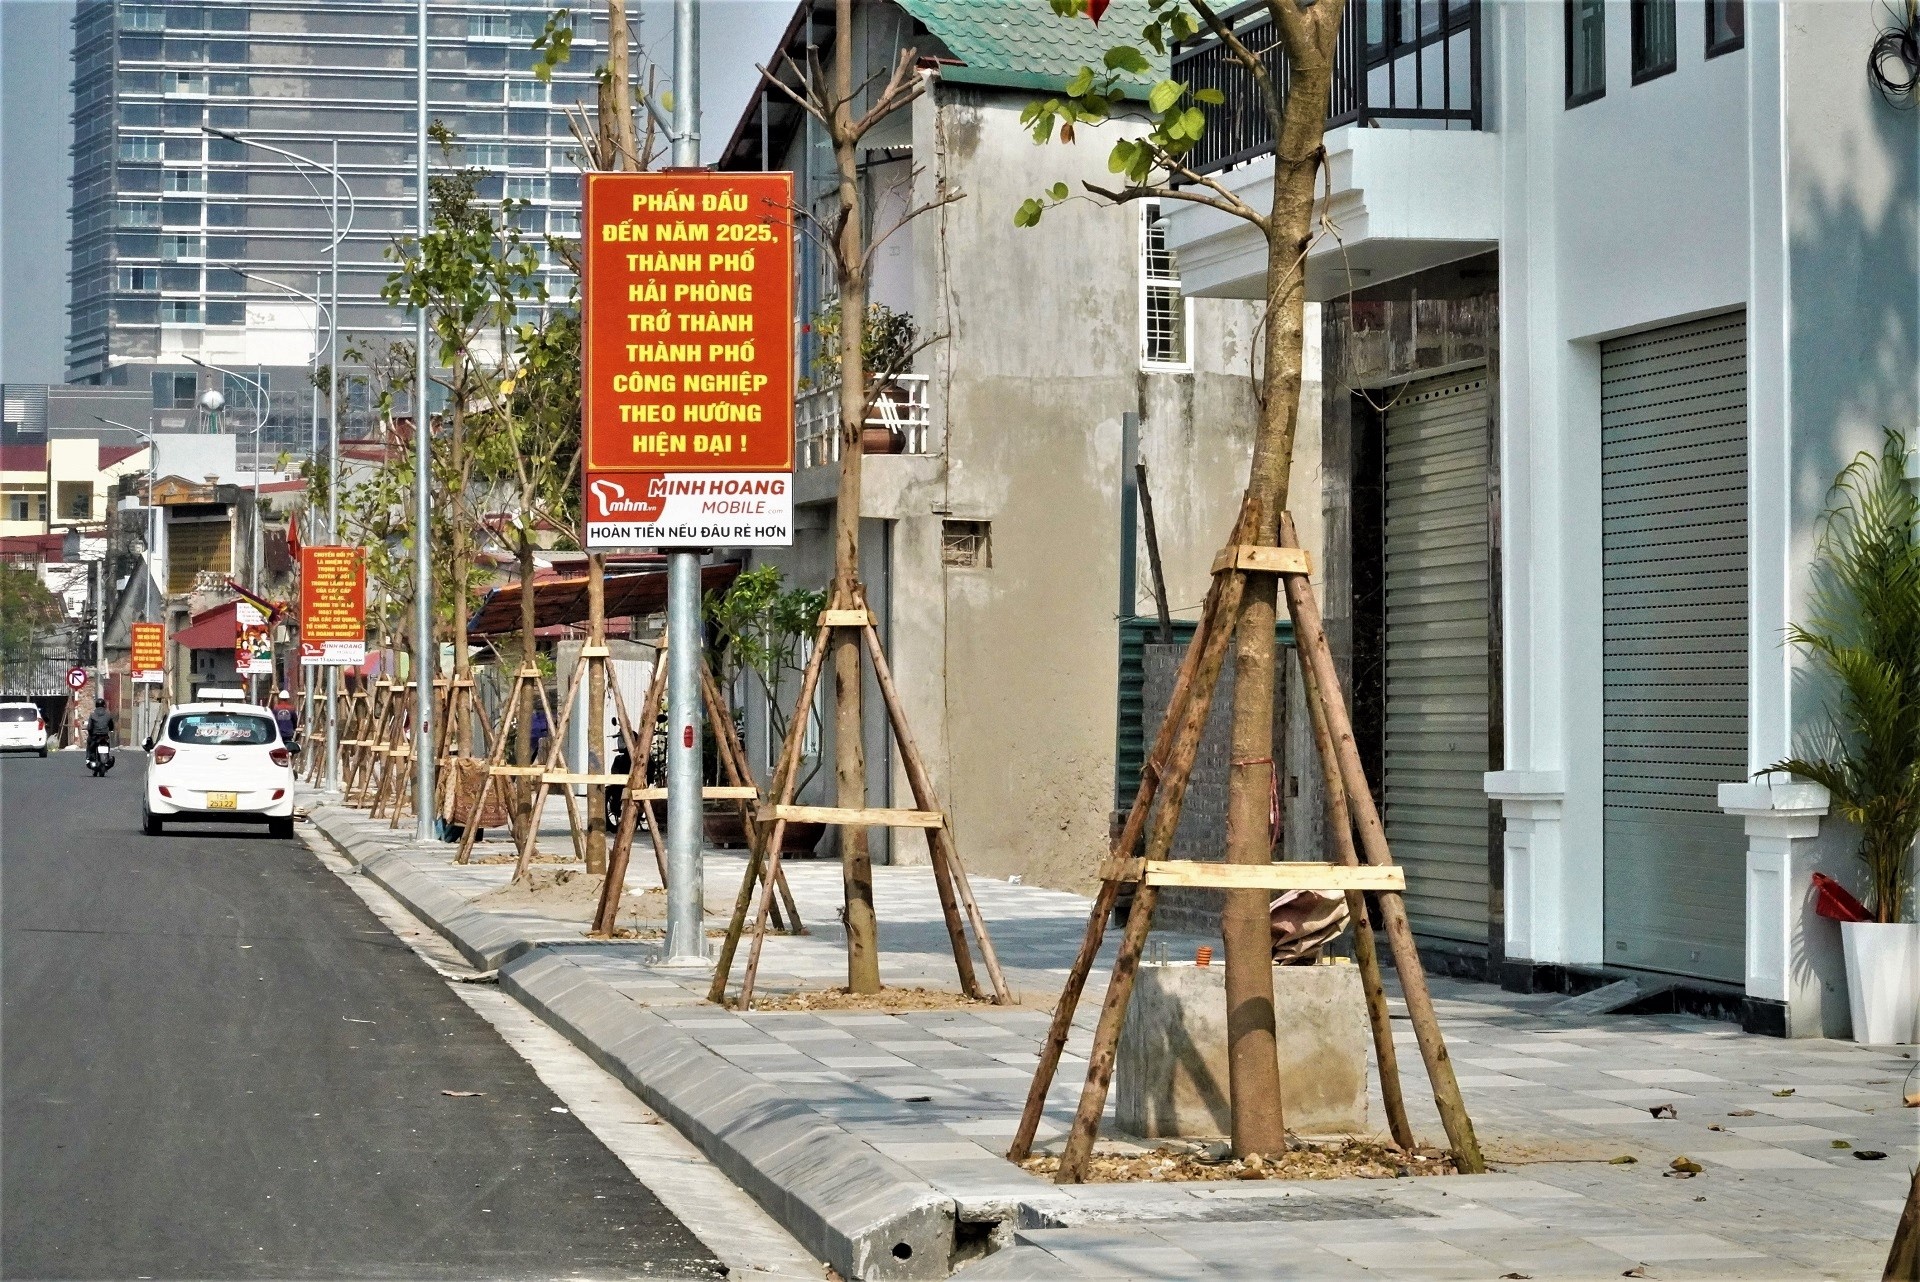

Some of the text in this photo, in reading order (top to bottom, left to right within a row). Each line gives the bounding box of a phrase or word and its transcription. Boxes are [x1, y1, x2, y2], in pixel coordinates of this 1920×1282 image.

[633, 188, 748, 212] PHẤN ĐẤU
[602, 218, 778, 244] ĐẾN NĂM 2025,
[627, 248, 755, 272] THÀNH PHỐ
[629, 278, 753, 302] HẢI PHÒNG
[628, 308, 753, 332] TRỞ THÀNH
[626, 338, 755, 362] THÀNH PHỐ
[613, 371, 768, 396] CÔNG NGHIỆP
[619, 401, 762, 422] THEO HƯỚNG
[633, 432, 747, 457] HIỆN ĐẠI !
[648, 479, 785, 496] MINH HOANG
[701, 501, 766, 514] MOBILE
[590, 521, 786, 538] HOÀN TIỀN NẾU ĐÂU RẺ HƠN
